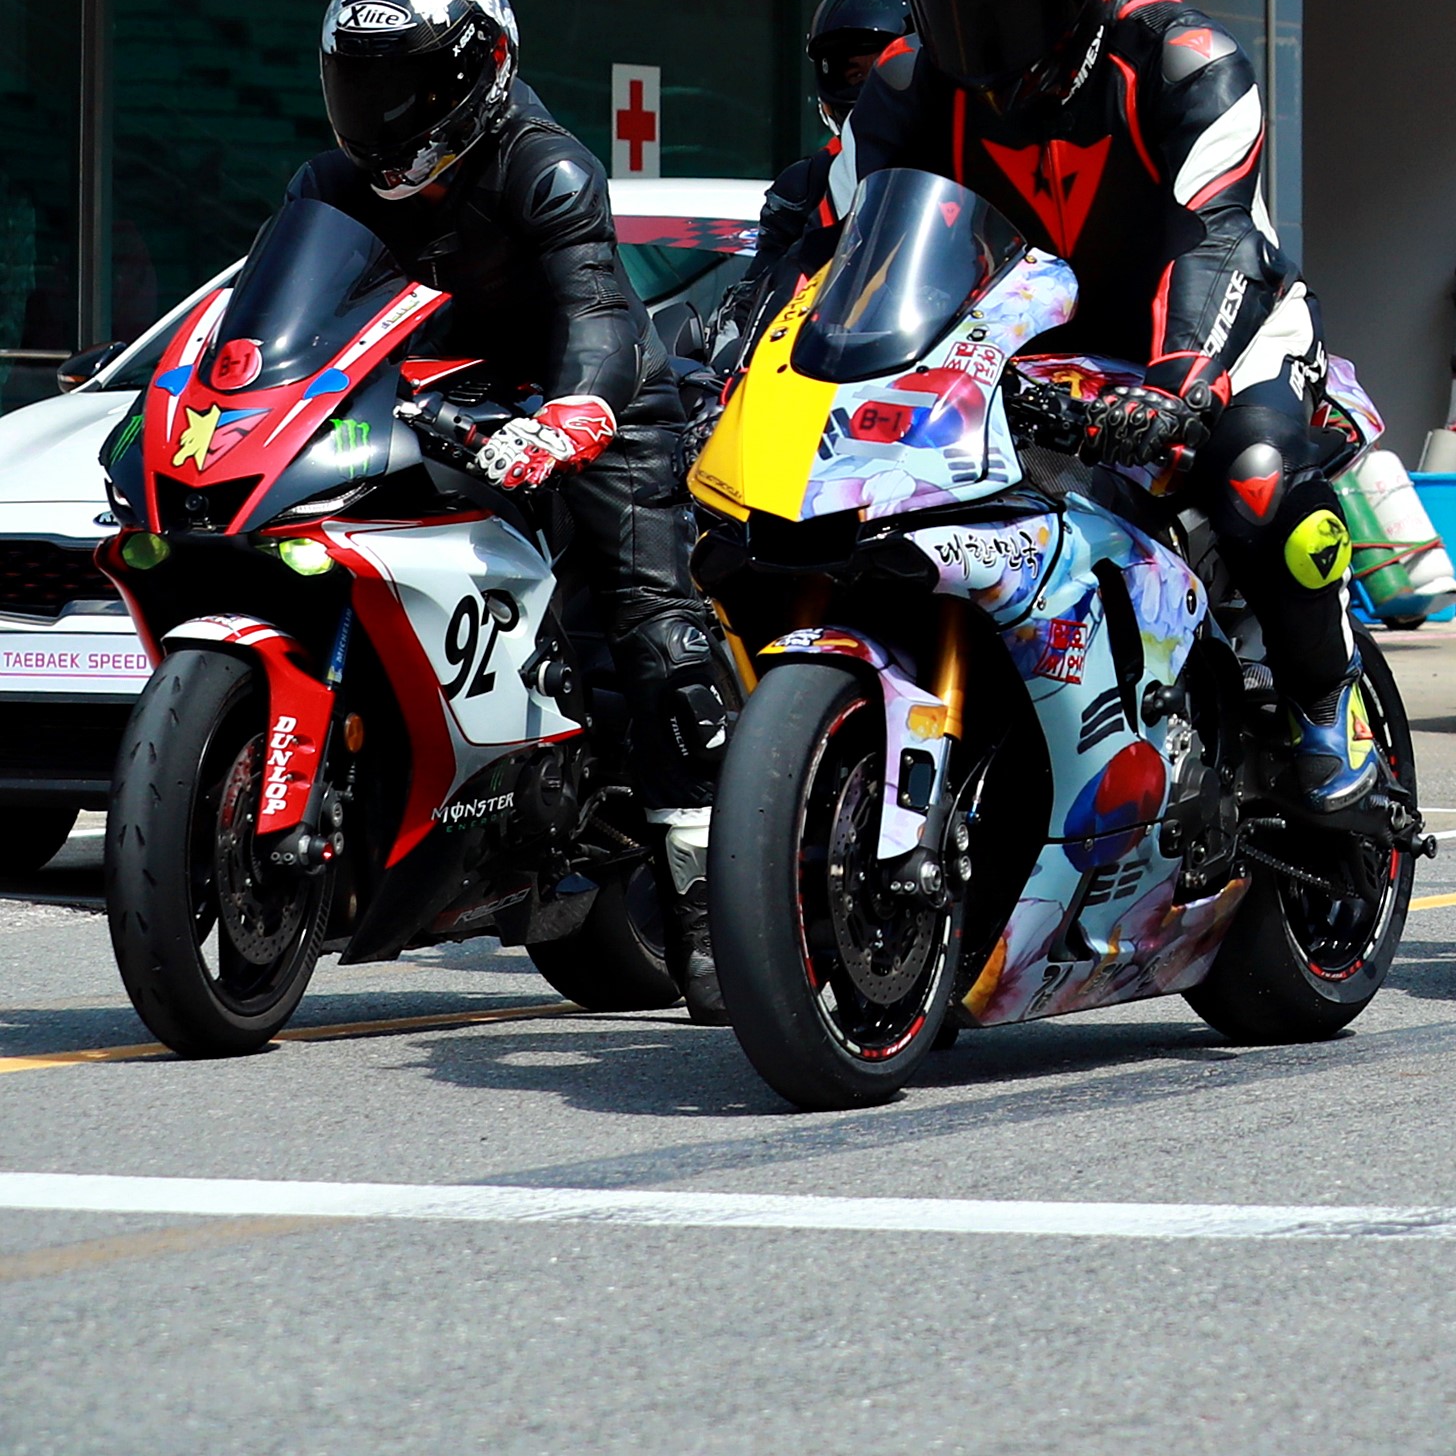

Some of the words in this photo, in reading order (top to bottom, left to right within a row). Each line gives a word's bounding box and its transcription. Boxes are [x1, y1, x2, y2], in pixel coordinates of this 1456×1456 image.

[345, 5, 399, 28] X-lite
[859, 408, 903, 433] B-1
[934, 530, 1039, 580] 대한민국
[335, 606, 353, 664] MICHELIN
[440, 589, 520, 702] 92
[3, 651, 81, 670] TAEBAEK
[88, 652, 147, 671] SPEED
[262, 715, 297, 815] DUNLOP
